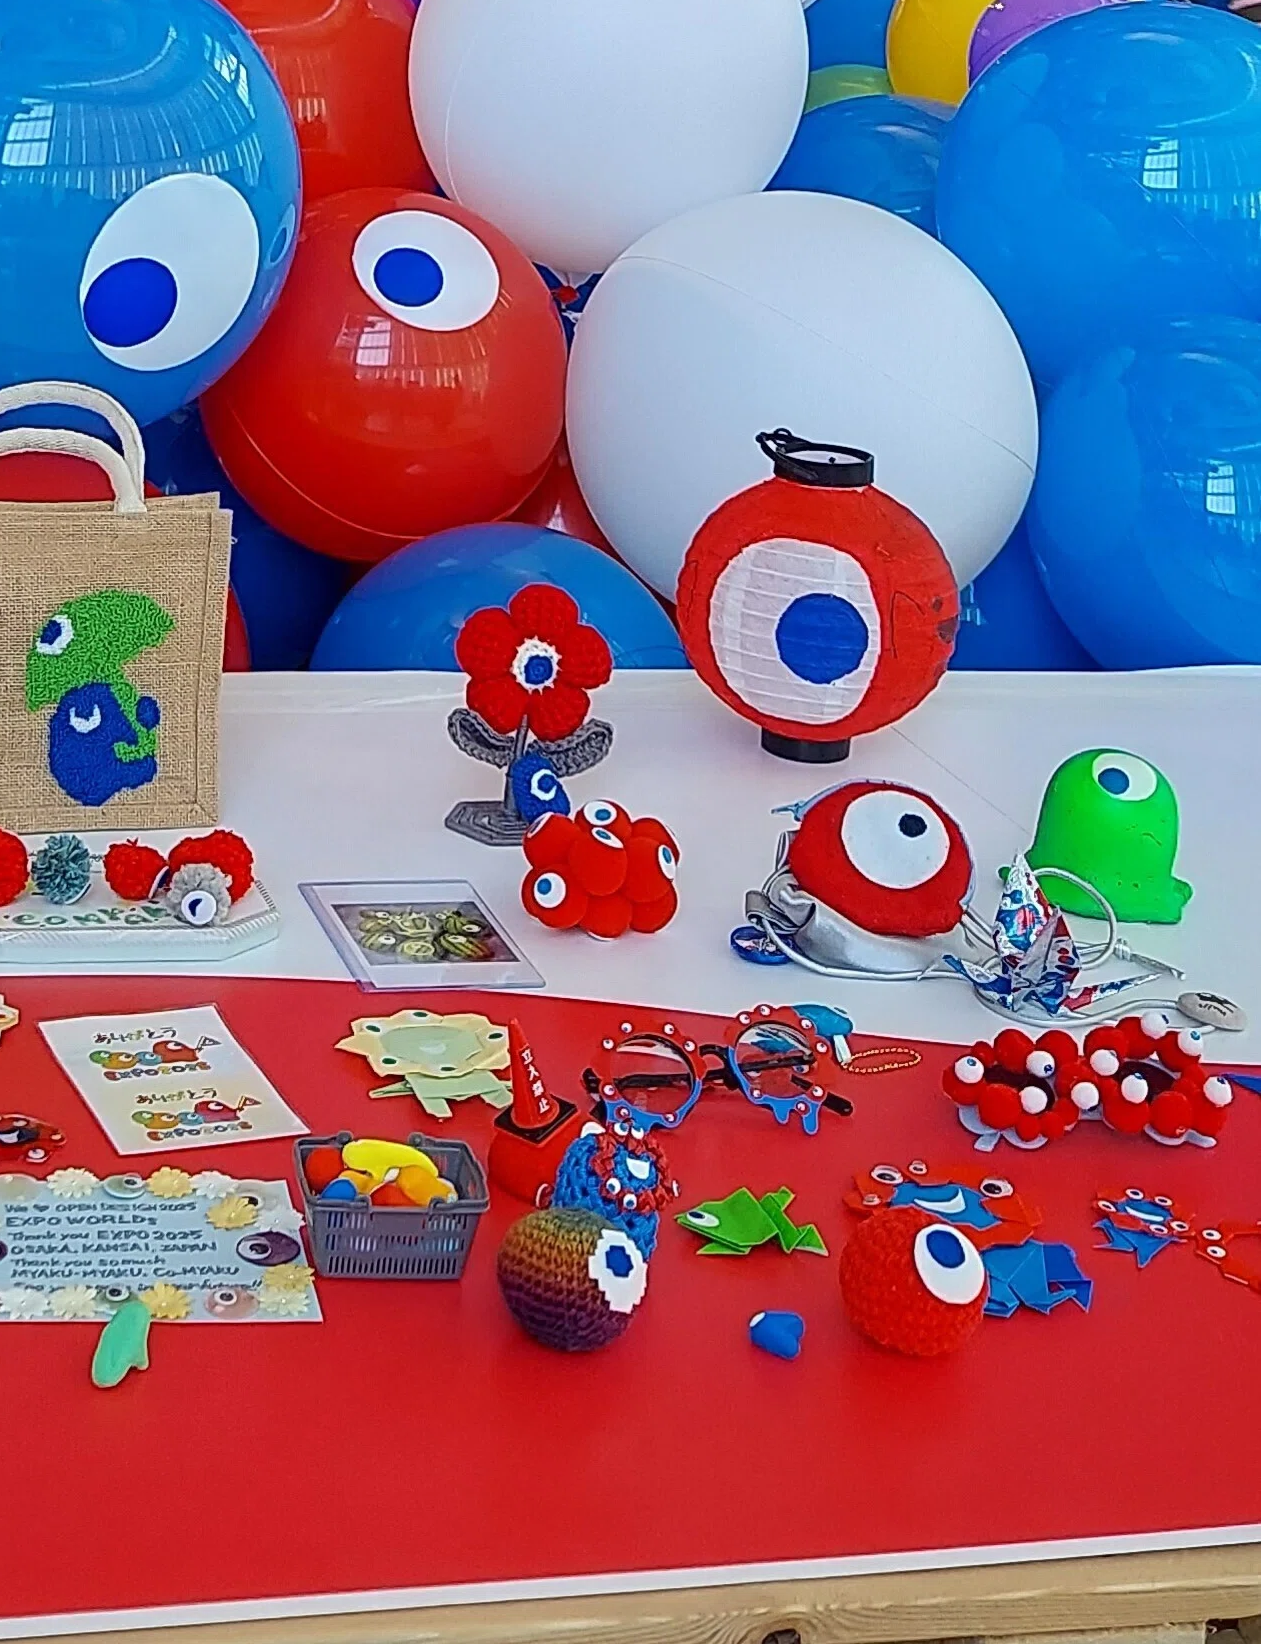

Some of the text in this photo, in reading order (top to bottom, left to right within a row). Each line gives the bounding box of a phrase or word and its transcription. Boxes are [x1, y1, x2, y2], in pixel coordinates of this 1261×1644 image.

[94, 1026, 178, 1044] ありがとう
[136, 1087, 218, 1105] ありがとう
[4, 1203, 28, 1213] We
[6, 1215, 158, 1227] EXPO WORLDs
[7, 1229, 203, 1241] Thank you EXPO 2025
[10, 1258, 59, 1267] Thank
[64, 1258, 93, 1267] you
